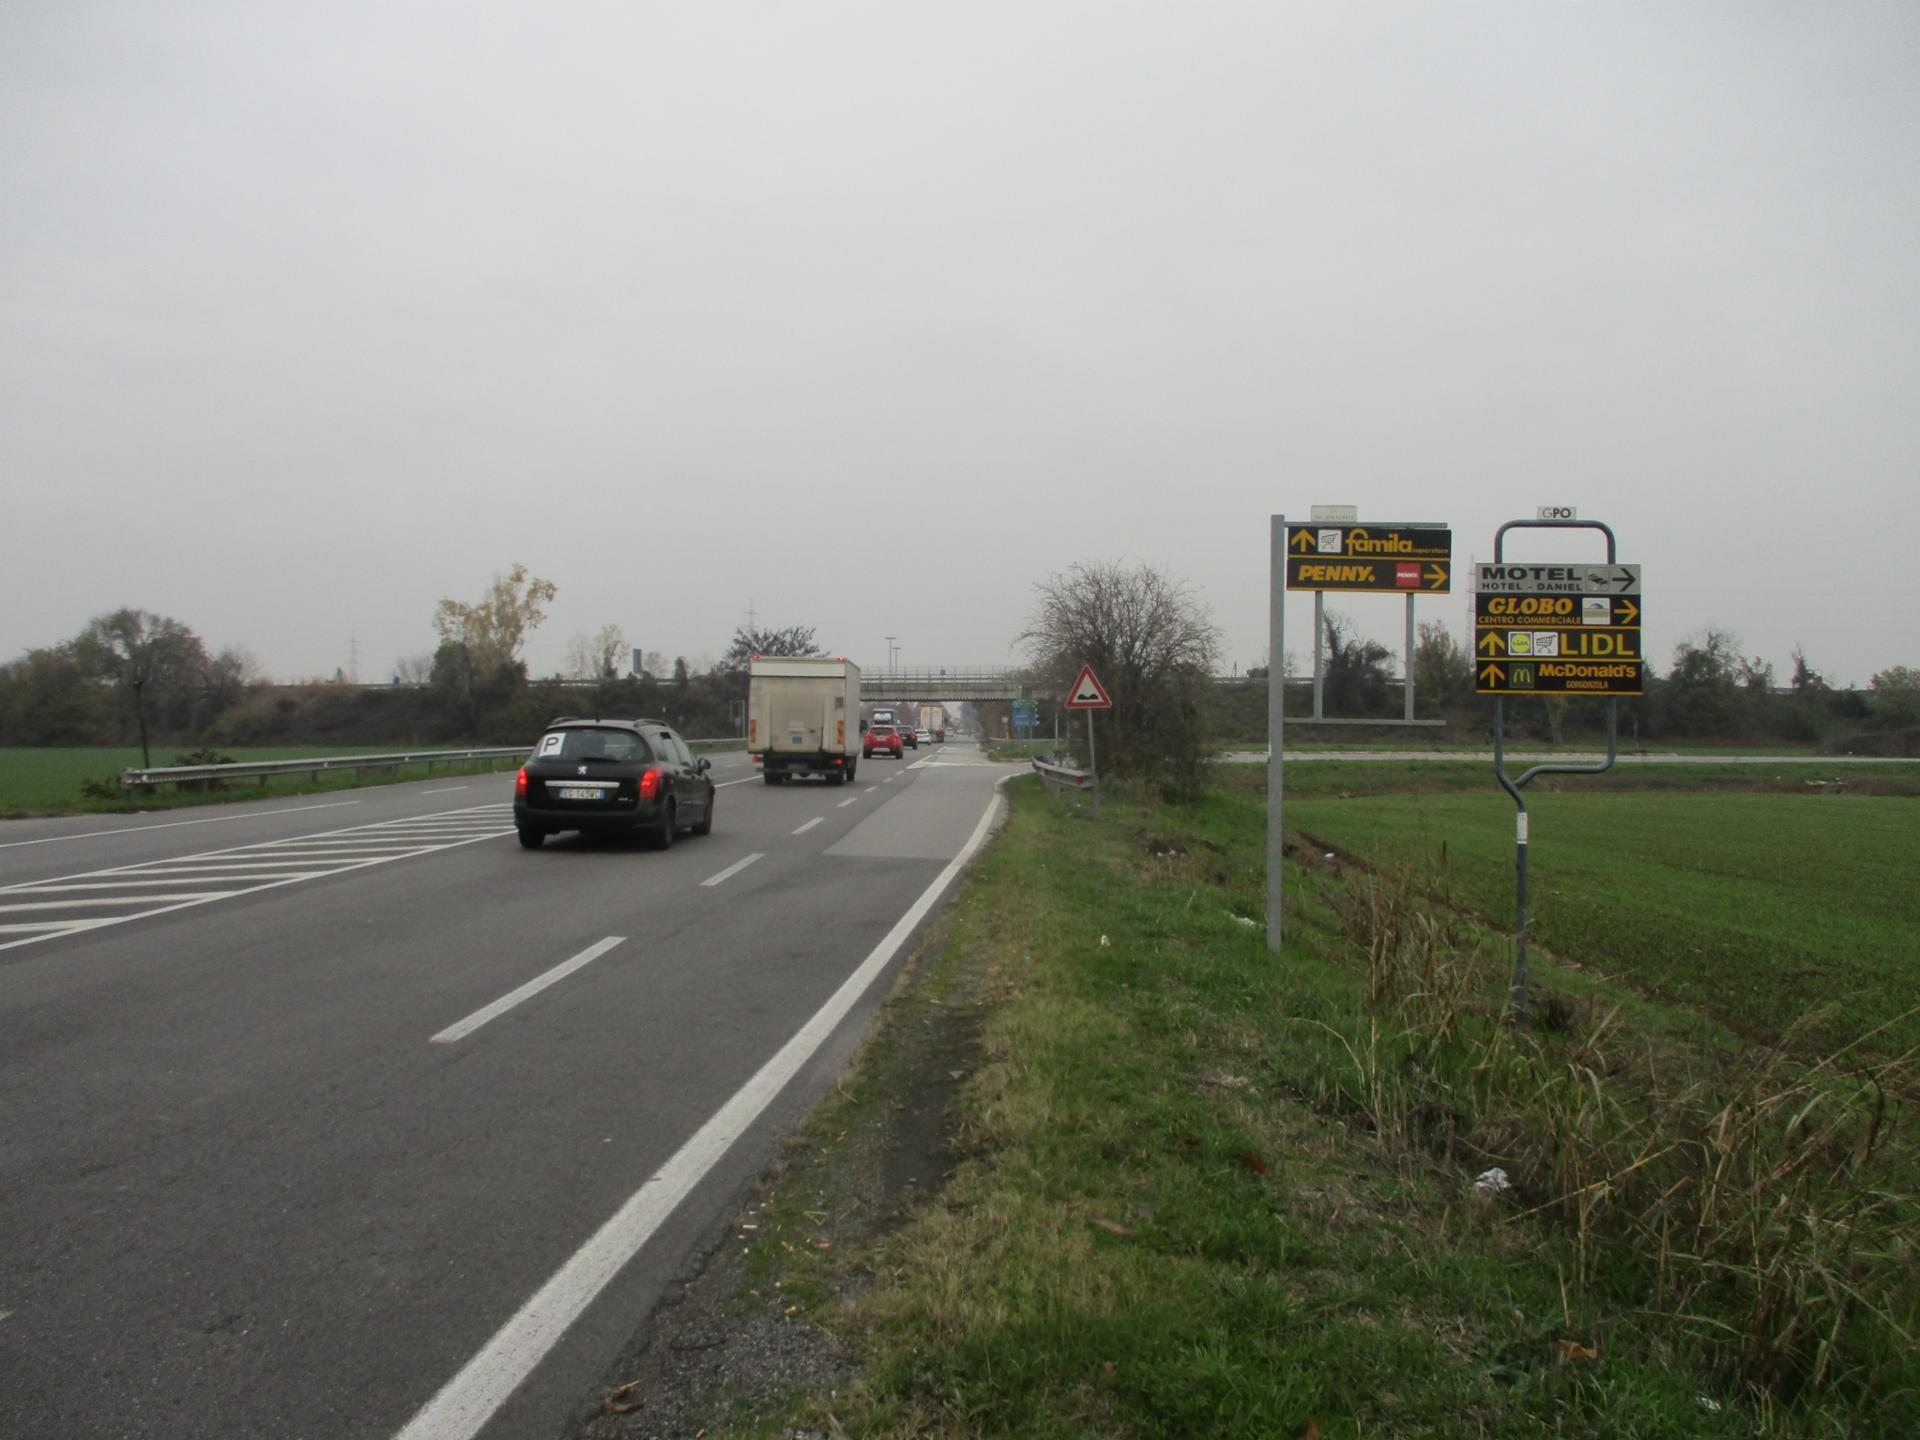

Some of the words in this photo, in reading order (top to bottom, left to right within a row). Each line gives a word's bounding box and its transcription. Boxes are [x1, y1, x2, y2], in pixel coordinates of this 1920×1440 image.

[1542, 508, 1571, 519] GPO
[1345, 528, 1413, 556] famila
[1482, 567, 1582, 581] MOTEL
[1482, 582, 1522, 591] HOTEL
[1537, 583, 1582, 592] DANIEL
[1488, 597, 1573, 615] GLOBO
[1478, 616, 1515, 625] CENTRO
[1517, 616, 1582, 625] COMMERCIALE
[1560, 633, 1635, 656] LIDL
[1539, 663, 1636, 678] McDonald's
[1566, 680, 1608, 689] GORGONZOLA
[543, 736, 559, 753] P
